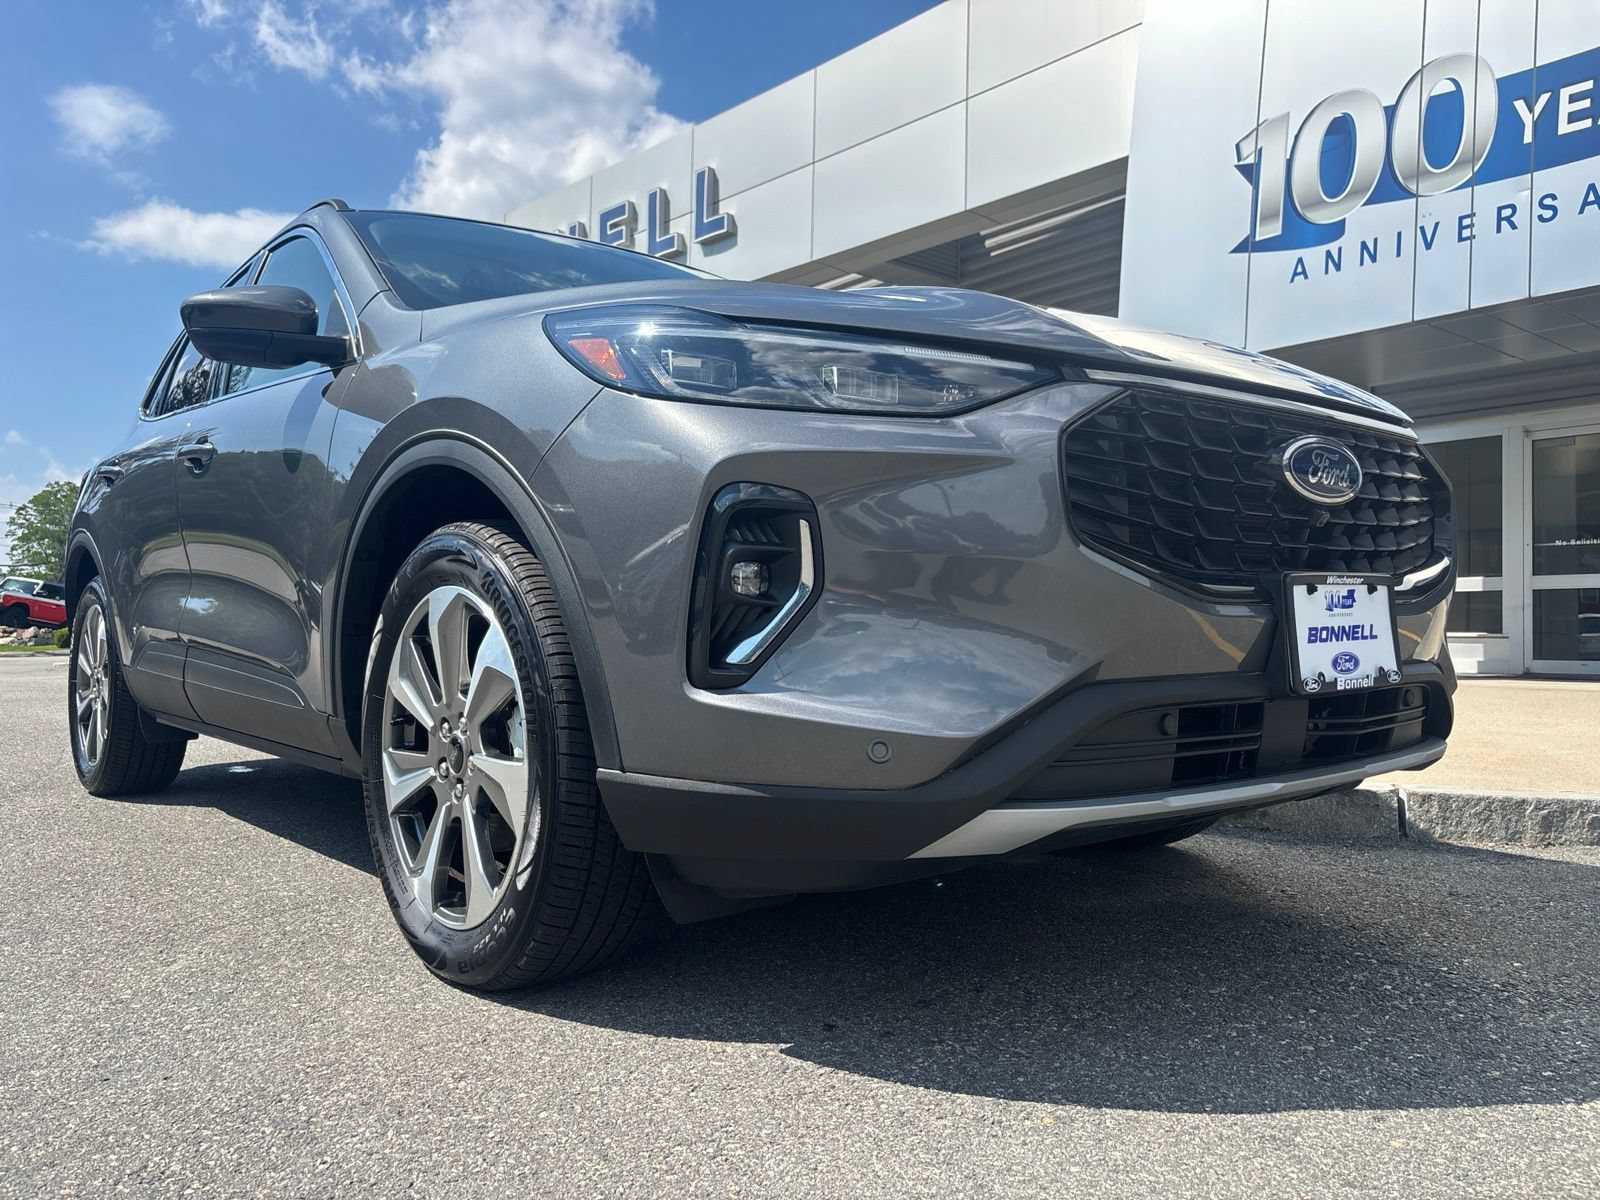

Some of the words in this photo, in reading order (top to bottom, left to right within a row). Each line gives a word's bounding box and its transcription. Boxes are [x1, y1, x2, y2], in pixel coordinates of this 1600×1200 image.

[1234, 52, 1498, 242] 100
[1513, 79, 1600, 145] YE
[555, 166, 738, 257] ELL
[1289, 182, 1600, 284] ANNIVERSA
[1308, 449, 1353, 488] Ford
[1326, 575, 1364, 584] Winchester
[479, 571, 539, 746] BRIDGESTONE
[1307, 624, 1378, 644] BONNELL
[1336, 674, 1374, 690] Bonnell
